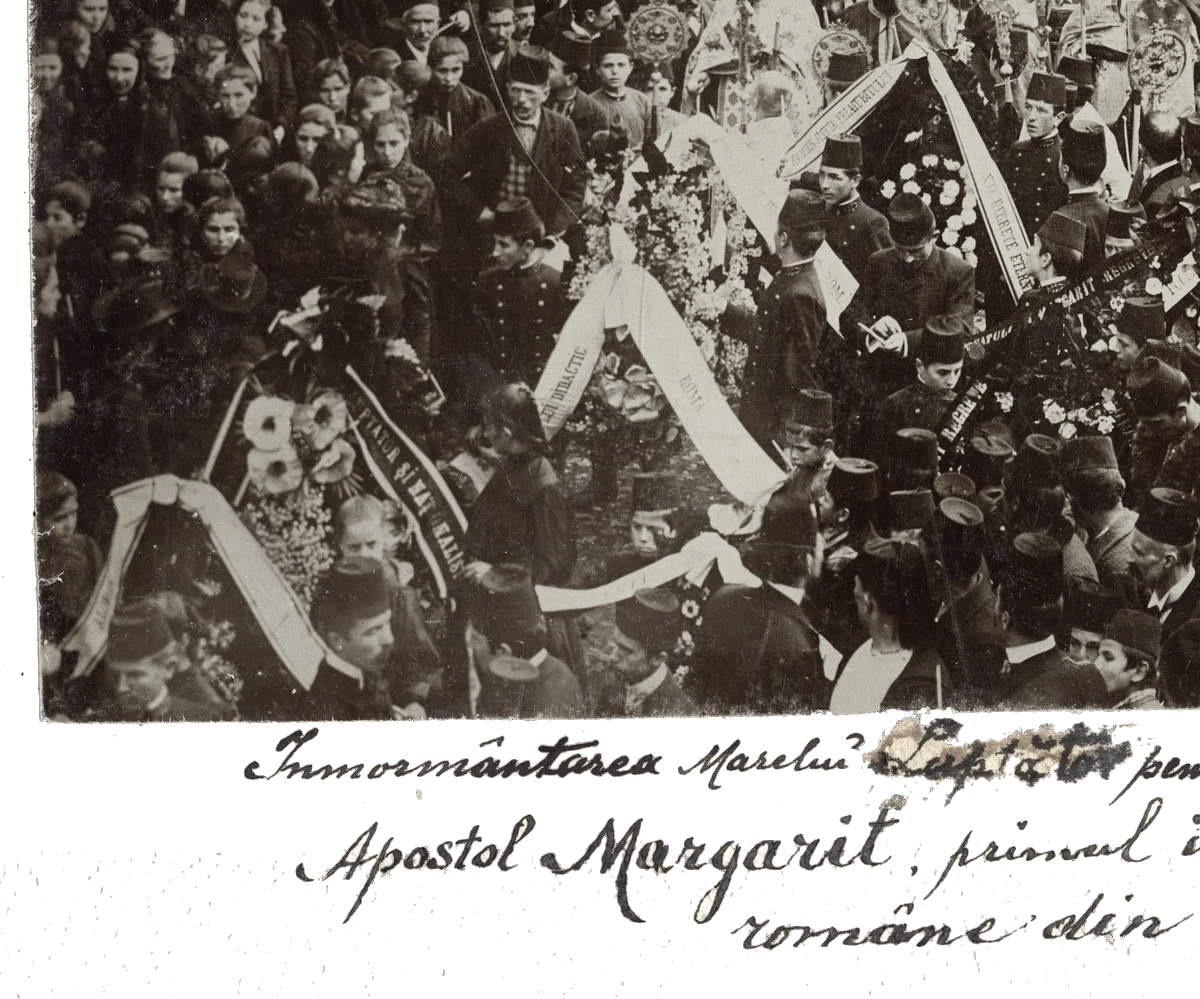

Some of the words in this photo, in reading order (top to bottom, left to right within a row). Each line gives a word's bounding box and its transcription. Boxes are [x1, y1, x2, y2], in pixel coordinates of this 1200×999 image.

[1010, 253, 1033, 291] ETERN
[296, 814, 536, 924] Apostol
[924, 798, 1163, 900] primul
[731, 902, 1020, 949] române
[1042, 893, 1194, 939] din
